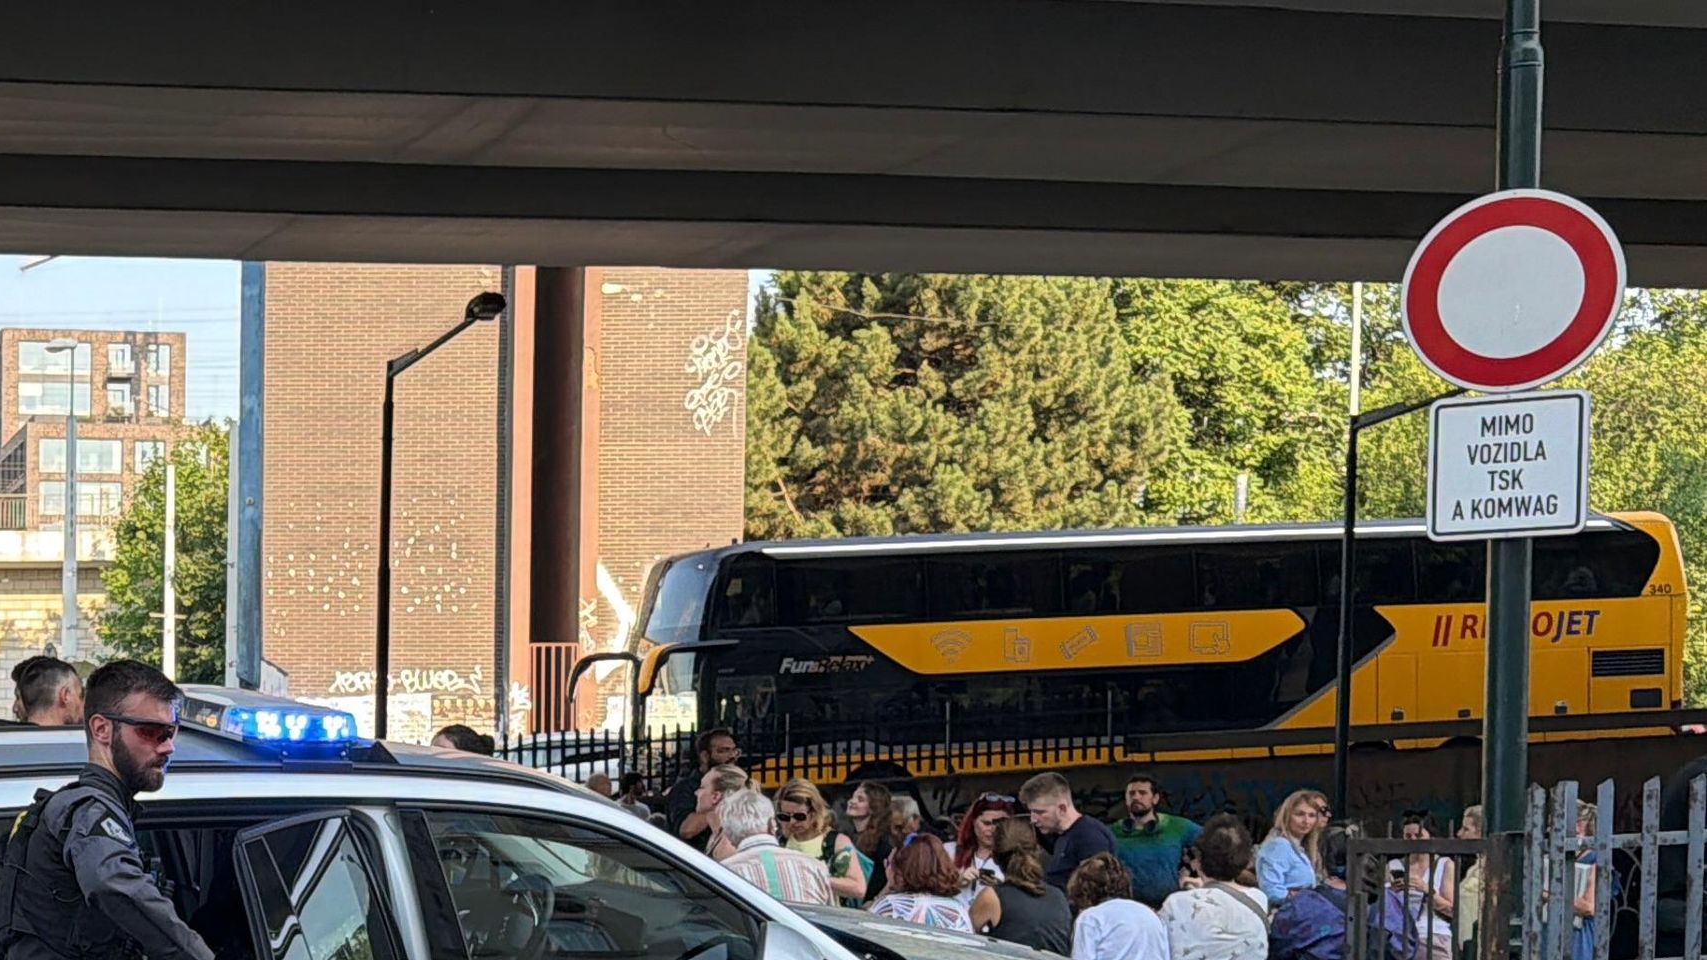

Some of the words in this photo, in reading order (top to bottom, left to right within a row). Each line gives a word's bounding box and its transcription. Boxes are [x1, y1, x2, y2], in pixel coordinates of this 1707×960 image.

[1480, 413, 1534, 437] MIMO
[1467, 440, 1547, 465] VOZIDLA
[1487, 468, 1524, 491] TSK
[1451, 499, 1464, 521] A
[1470, 494, 1558, 519] KOMWAG
[1649, 584, 1672, 594] 340
[1460, 610, 1600, 643] ROJET
